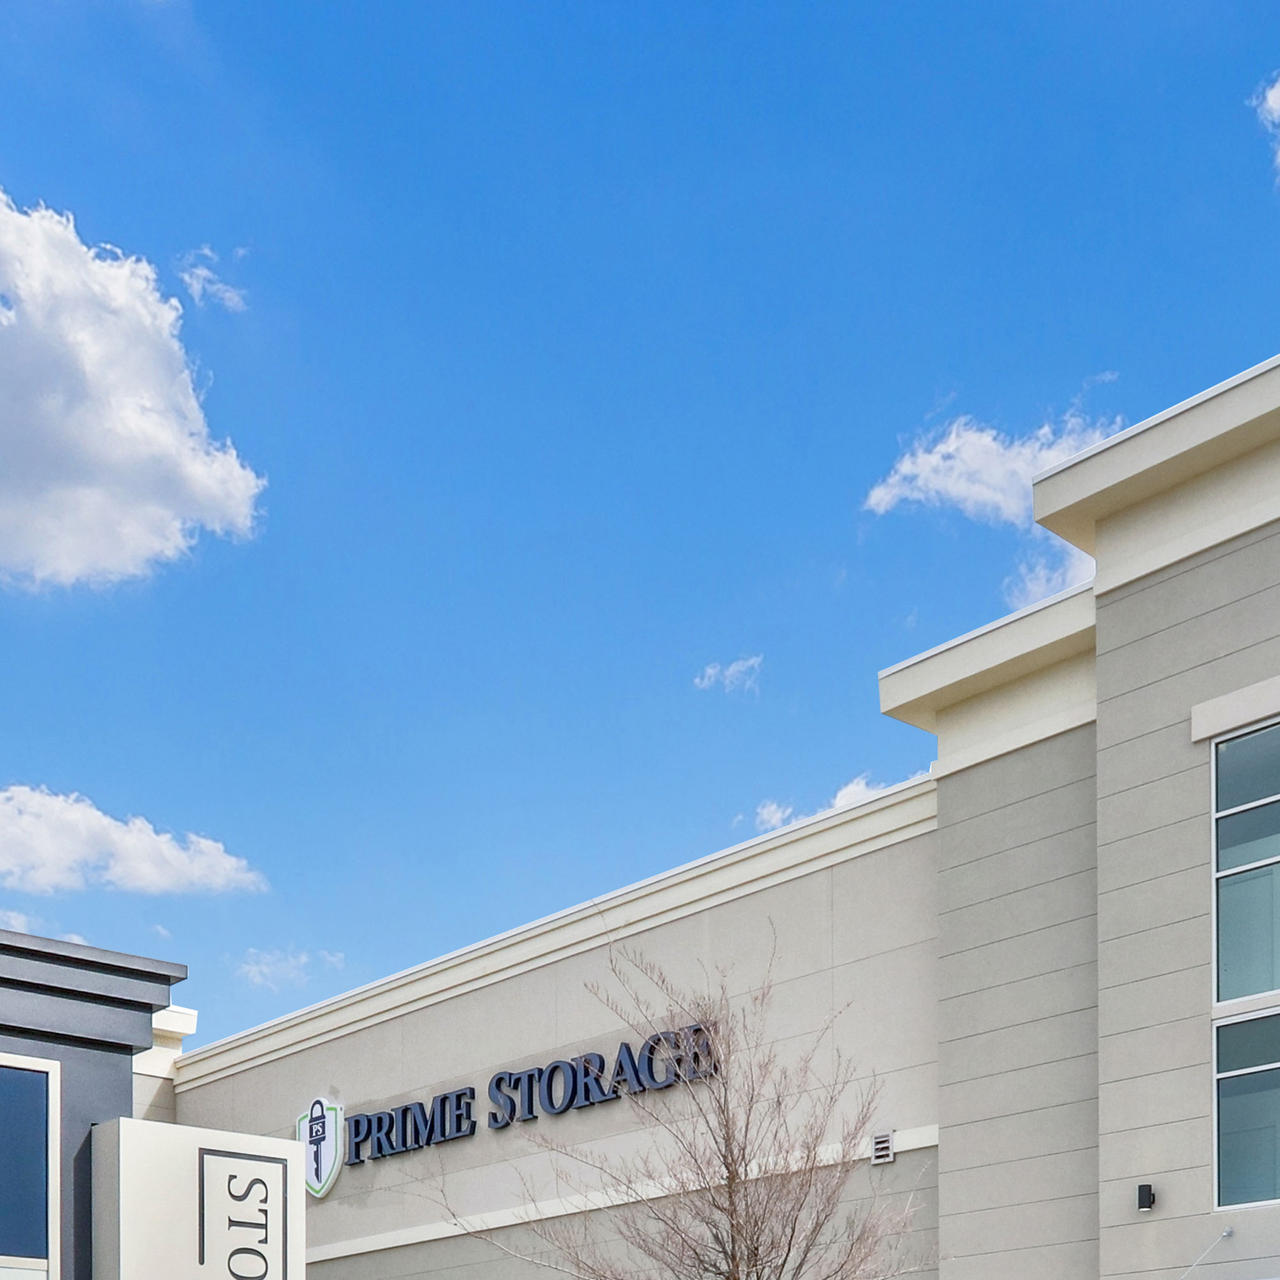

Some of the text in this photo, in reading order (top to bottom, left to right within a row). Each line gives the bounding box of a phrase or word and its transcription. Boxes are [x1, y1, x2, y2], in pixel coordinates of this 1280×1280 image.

[312, 1122, 323, 1137] PS
[344, 1023, 719, 1167] PRIME STORAGE
